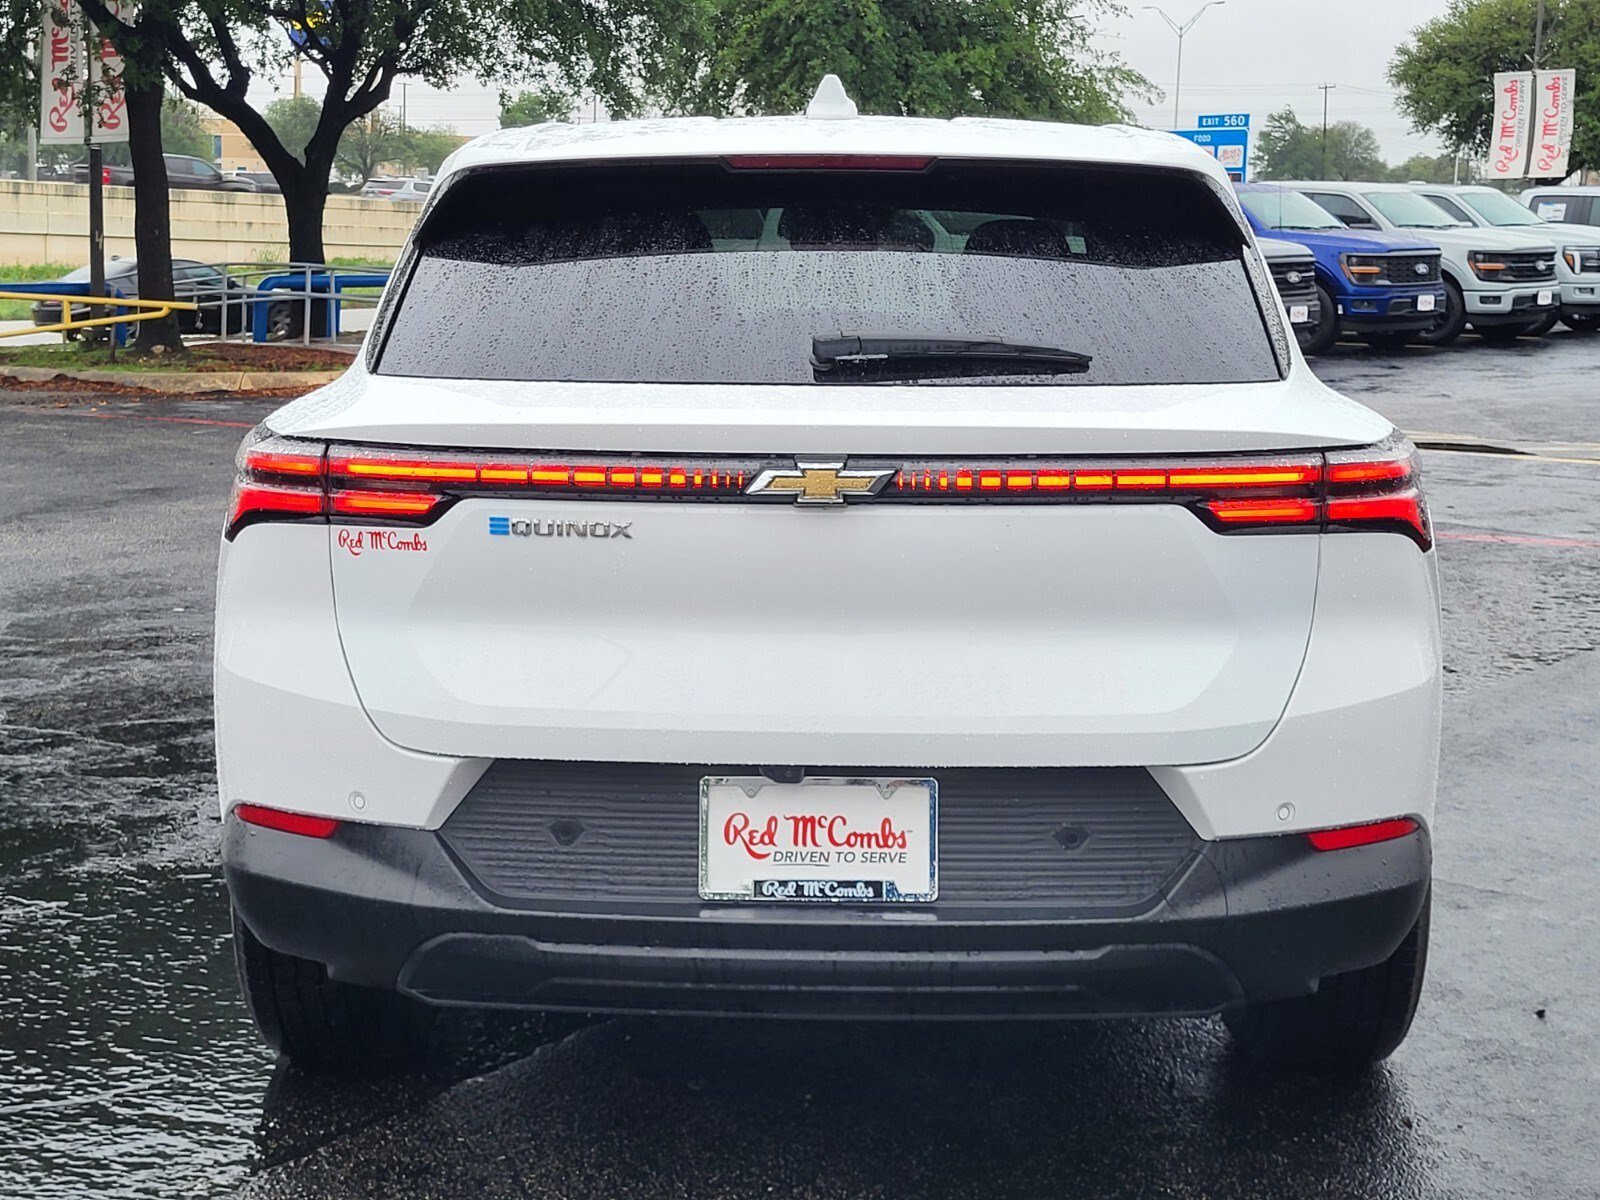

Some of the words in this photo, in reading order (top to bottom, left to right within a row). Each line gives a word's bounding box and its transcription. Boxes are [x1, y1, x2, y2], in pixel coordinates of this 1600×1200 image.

[1202, 117, 1219, 126] EXIT
[1224, 115, 1245, 126] 560
[1500, 79, 1518, 142] McCombs
[1541, 76, 1561, 142] McCombs
[1495, 145, 1519, 172] Red
[1537, 143, 1561, 171] Red
[489, 516, 633, 539] EQUINOX
[338, 529, 363, 556] Red
[366, 531, 428, 552] McCombs
[723, 812, 779, 860] Red
[783, 814, 908, 849] McCombs
[773, 851, 830, 864] DRIVEN
[836, 851, 855, 863] TO
[860, 851, 907, 864] SERVE
[761, 880, 797, 898] Red
[797, 880, 875, 898] McCombs
